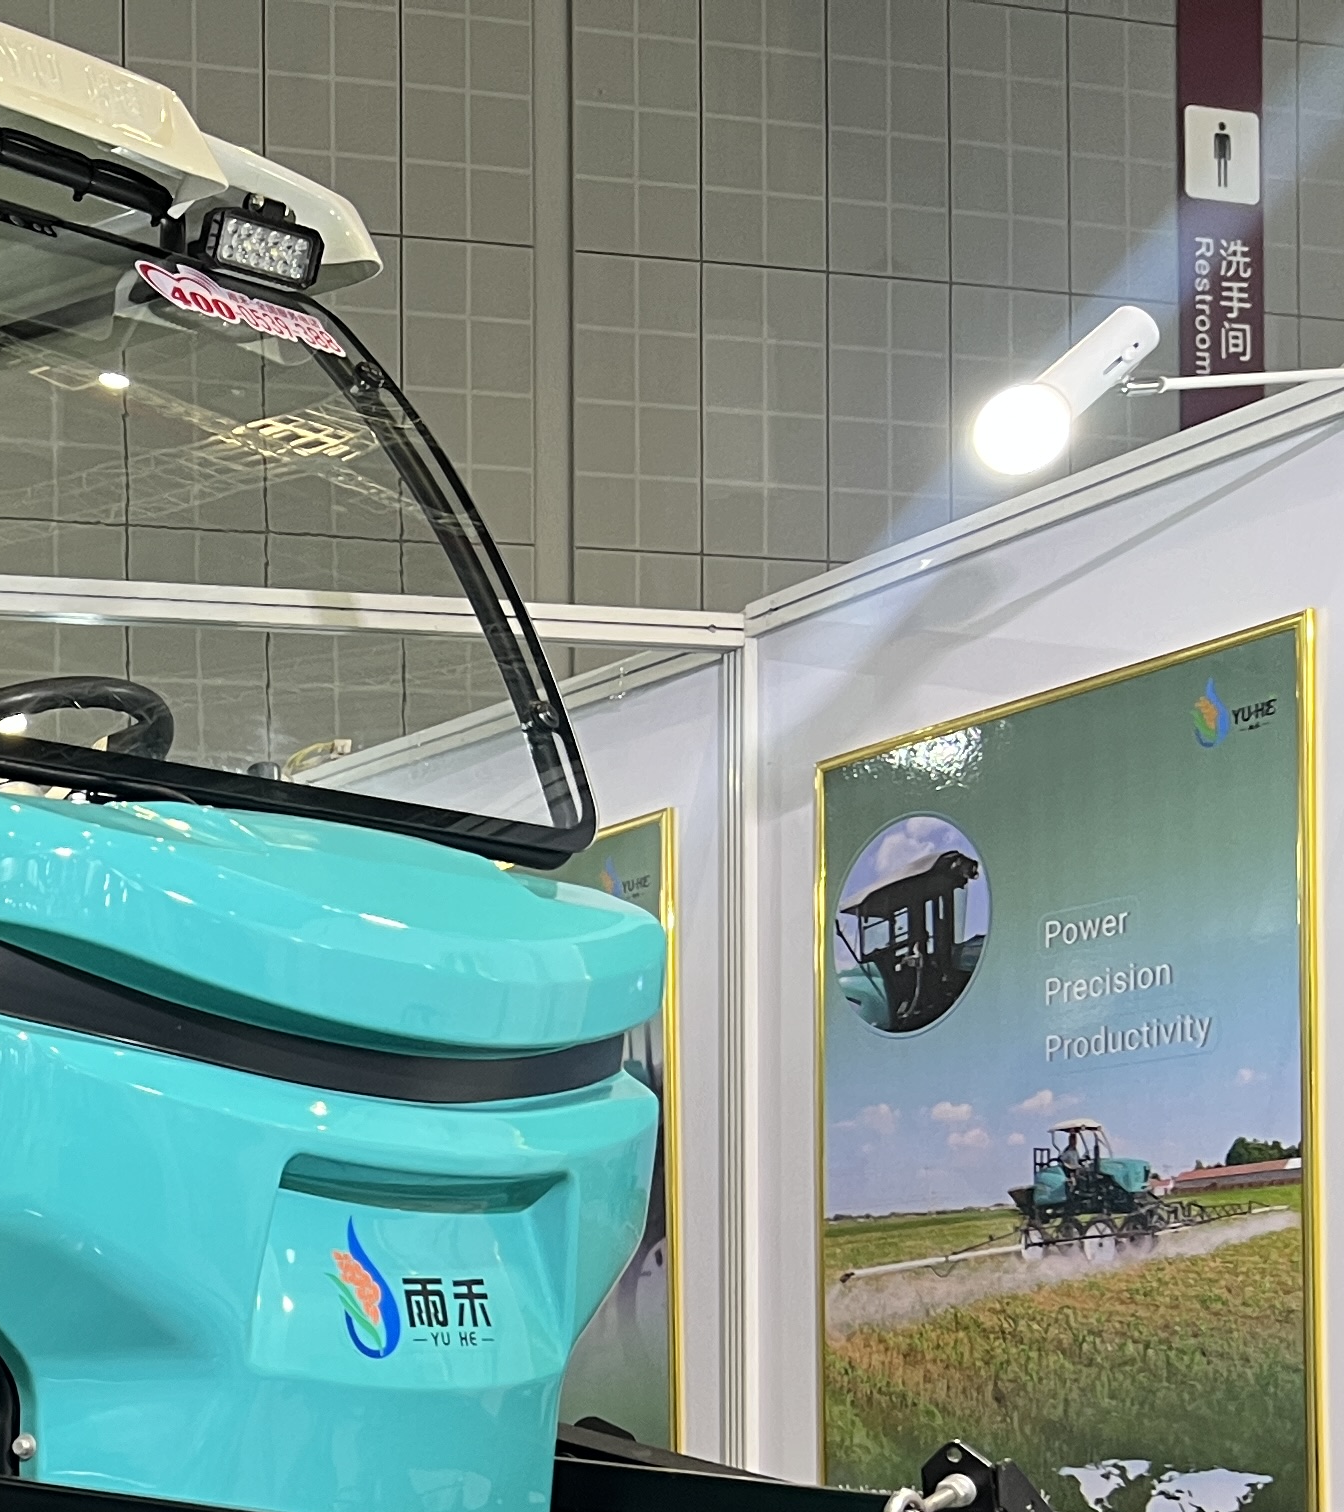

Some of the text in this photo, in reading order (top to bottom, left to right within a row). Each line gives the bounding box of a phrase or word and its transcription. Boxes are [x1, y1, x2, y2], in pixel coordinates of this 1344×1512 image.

[1194, 237, 1214, 375] Restroom
[1219, 239, 1253, 362] 洗手间
[1044, 911, 1131, 949] Power
[1044, 963, 1173, 1006] Precision
[1045, 1014, 1213, 1062] Productivity
[401, 1277, 492, 1328] 雨禾
[430, 1331, 479, 1347] YU HE
